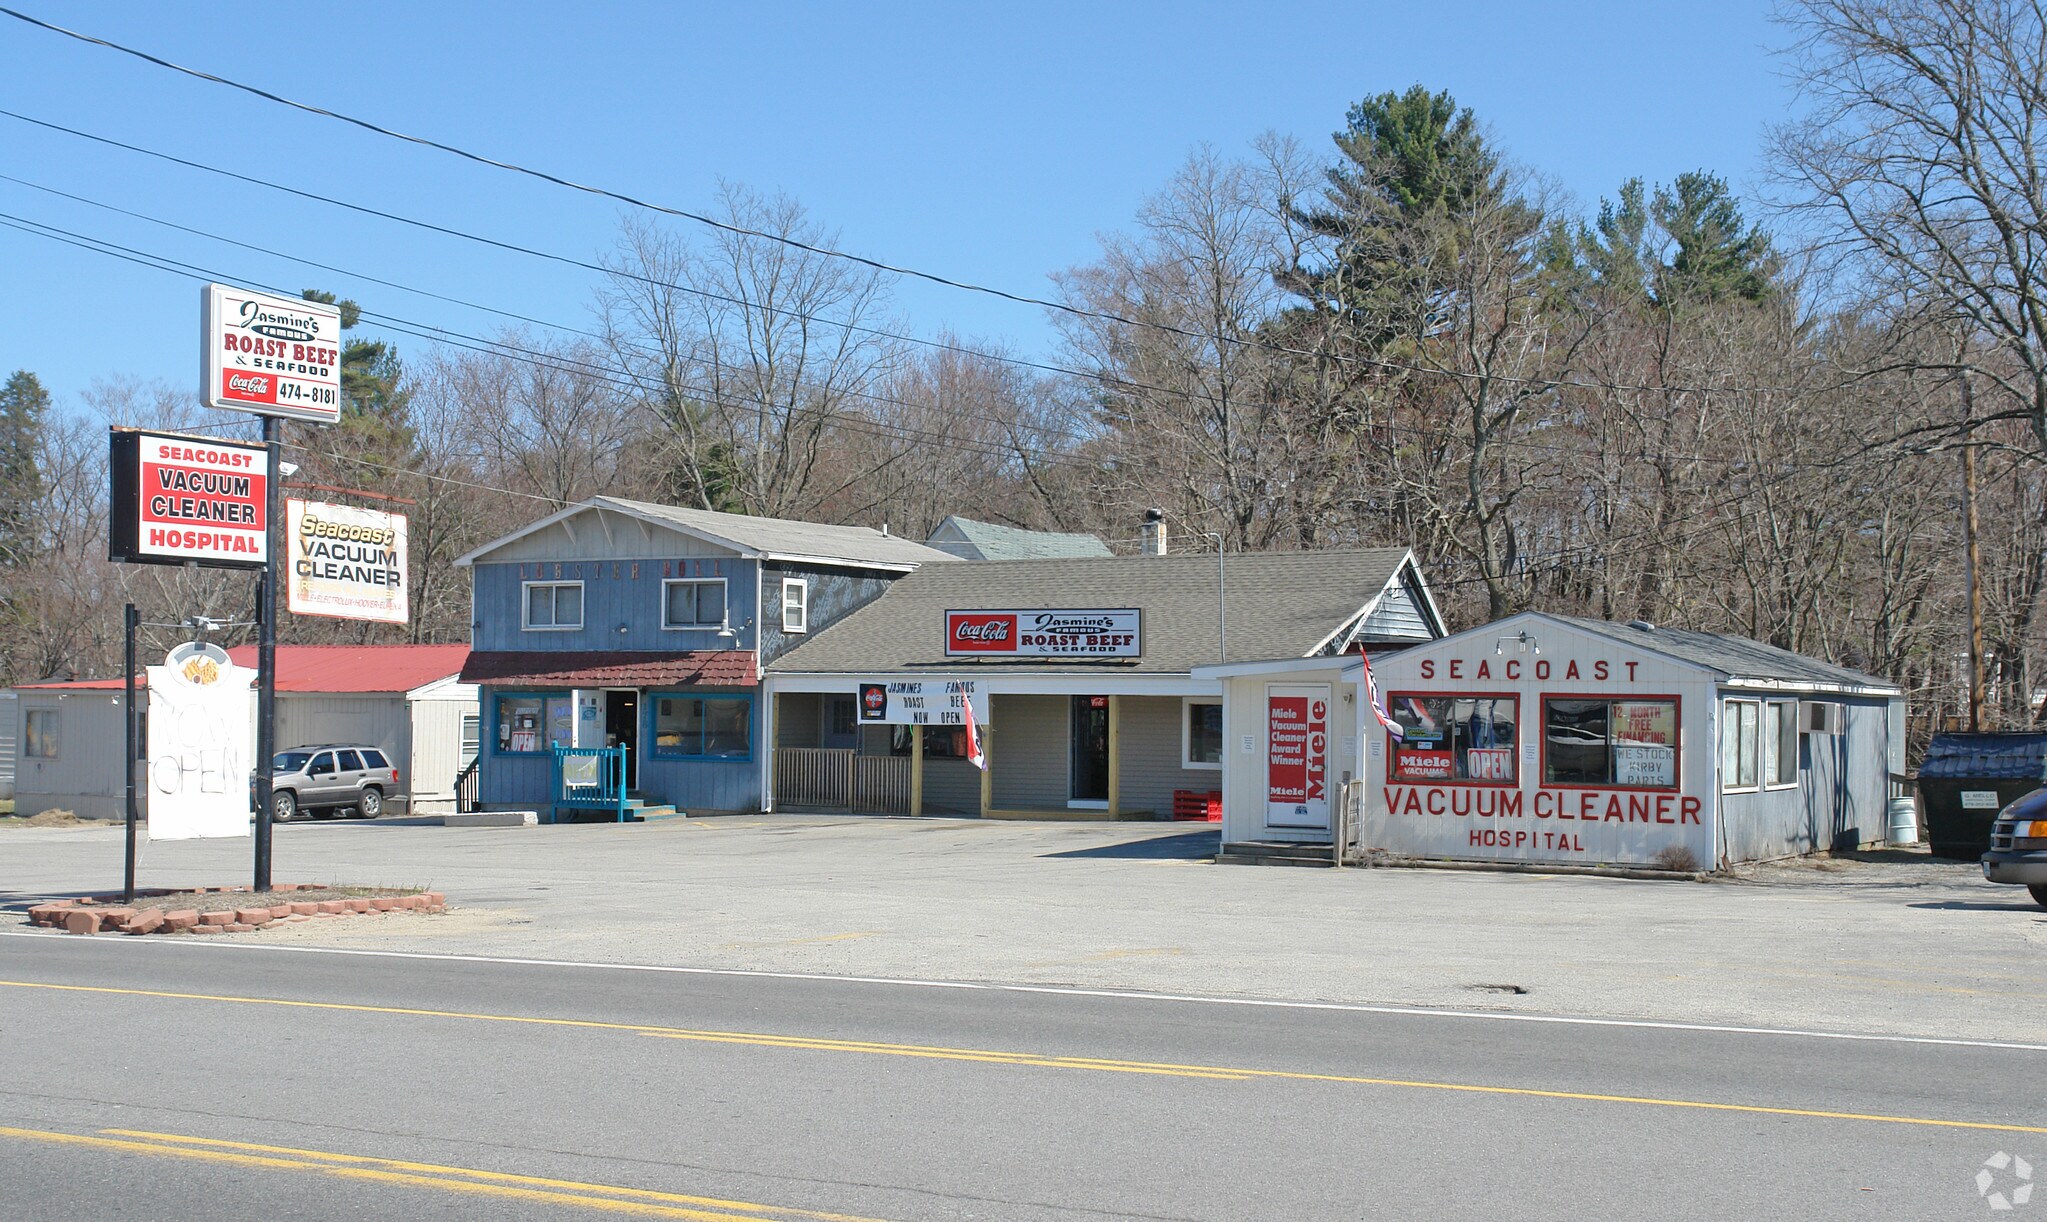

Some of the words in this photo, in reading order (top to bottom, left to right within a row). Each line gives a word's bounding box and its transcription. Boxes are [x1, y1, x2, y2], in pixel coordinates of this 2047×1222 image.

[240, 300, 320, 334] Jasmine's
[262, 326, 308, 341] FAMOUS
[224, 333, 287, 359] ROAST
[293, 343, 338, 367] BEEF
[235, 355, 248, 366] &
[253, 357, 329, 377] SEAFOOD
[228, 373, 270, 395] Coca-Cola
[279, 382, 336, 405] 474-8181
[159, 445, 253, 468] SEACOAST
[157, 467, 250, 498] VACUUM
[150, 495, 257, 525] CLEANER
[299, 513, 395, 547] Seacoast
[149, 528, 260, 554] HOSPITAL
[299, 539, 397, 567] VACUUM
[296, 559, 401, 588] CLEANER
[520, 561, 640, 580] LOBSTER
[662, 559, 723, 577] ROLL
[955, 620, 1011, 642] Coca-Cola
[1034, 613, 1114, 632] Jasmine's
[1021, 634, 1080, 646] ROAST
[1086, 634, 1135, 646] BEEF
[1420, 659, 1640, 683] SEACOAST
[888, 682, 922, 694] JASMINES
[903, 696, 925, 709] ROAST
[1613, 705, 1623, 718] 12
[1630, 706, 1661, 719] MONTH
[913, 711, 929, 724] NOW
[940, 711, 961, 724] OPEN
[1271, 708, 1297, 719] Miele
[1271, 720, 1307, 731] Vacuum
[1629, 719, 1652, 731] FREE
[513, 733, 536, 752] OPEN
[1271, 731, 1307, 743] Cleaner
[1617, 731, 1666, 744] FINANCING
[1271, 743, 1301, 754] Award
[1307, 700, 1327, 801] Miele
[1617, 749, 1632, 760] WE
[1636, 749, 1673, 760] STOCK
[1271, 755, 1305, 766] Winner
[1400, 755, 1451, 768] Miele
[1469, 751, 1511, 779] OPEN
[1629, 761, 1662, 773] KIRBY
[153, 746, 238, 795] OPEN
[1627, 775, 1664, 786] PARTS
[1270, 786, 1305, 796] Miele
[1383, 787, 1523, 818] VACUUM
[1533, 791, 1702, 826] CLEANER
[1469, 829, 1585, 852] HOSPITAL
